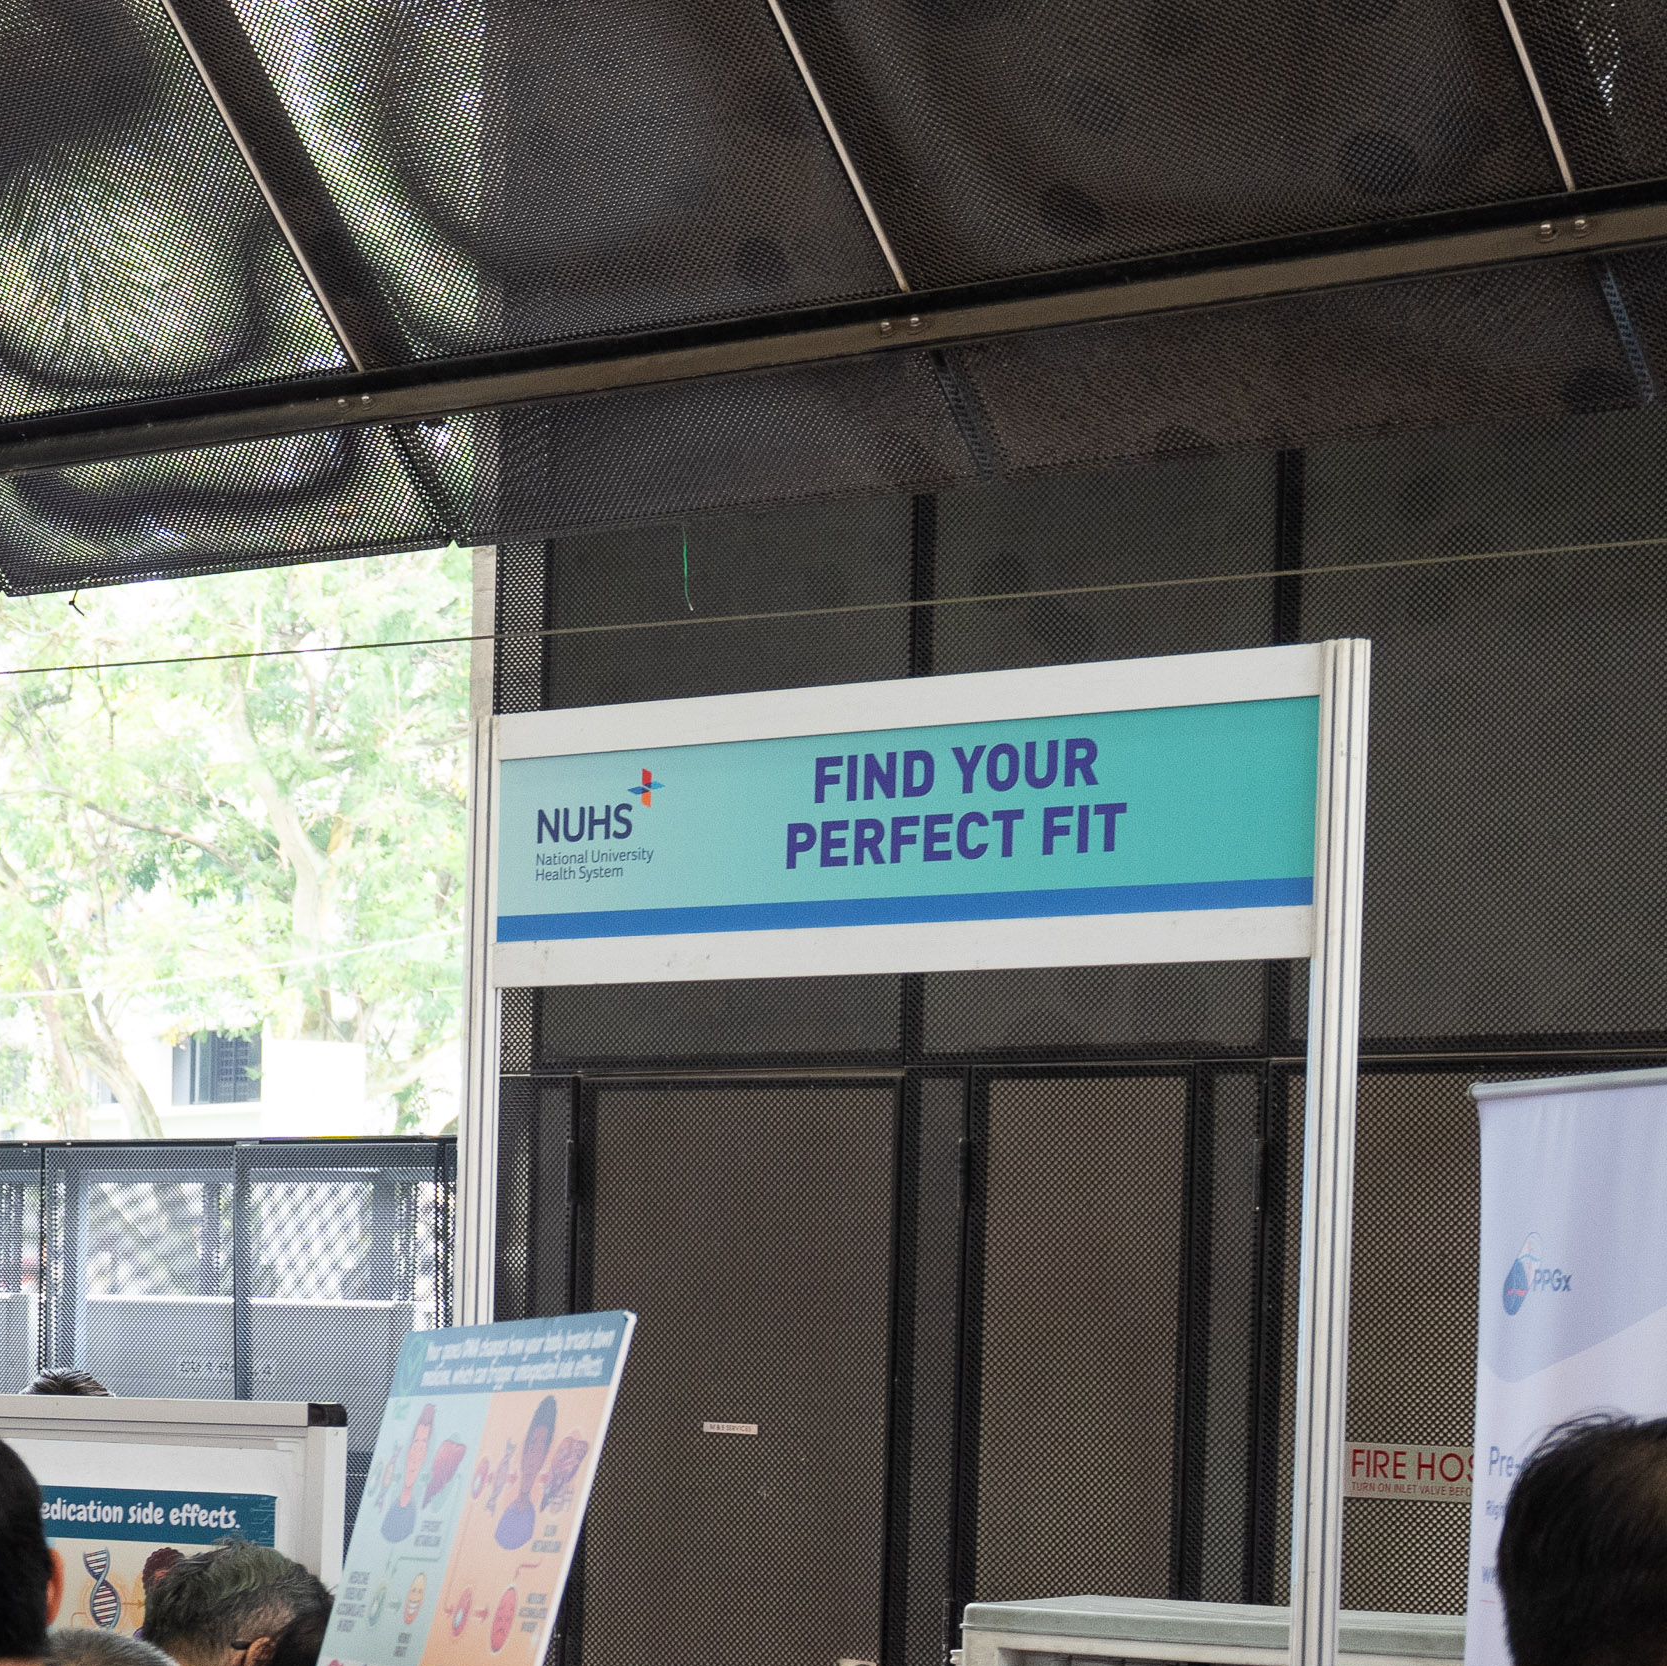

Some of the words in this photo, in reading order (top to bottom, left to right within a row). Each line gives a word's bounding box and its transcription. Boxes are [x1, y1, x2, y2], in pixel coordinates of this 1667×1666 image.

[814, 748, 935, 804] FIND
[952, 737, 1100, 797] YOUR
[537, 803, 633, 844] NUHS
[785, 811, 1029, 870] PERFECT
[1041, 802, 1128, 855] FIT
[536, 850, 588, 866] National
[591, 847, 654, 863] University
[535, 866, 576, 881] Health
[579, 864, 624, 882] System
[1533, 1268, 1573, 1293] PPGx
[1352, 1448, 1407, 1480] FIRE
[1417, 1451, 1474, 1483] HO
[1352, 1481, 1375, 1492] TURN
[1378, 1483, 1391, 1493] ON
[1394, 1484, 1417, 1495] INLET
[1419, 1485, 1446, 1497] VALVE
[128, 1502, 165, 1526] side
[169, 1503, 241, 1529] effects.
